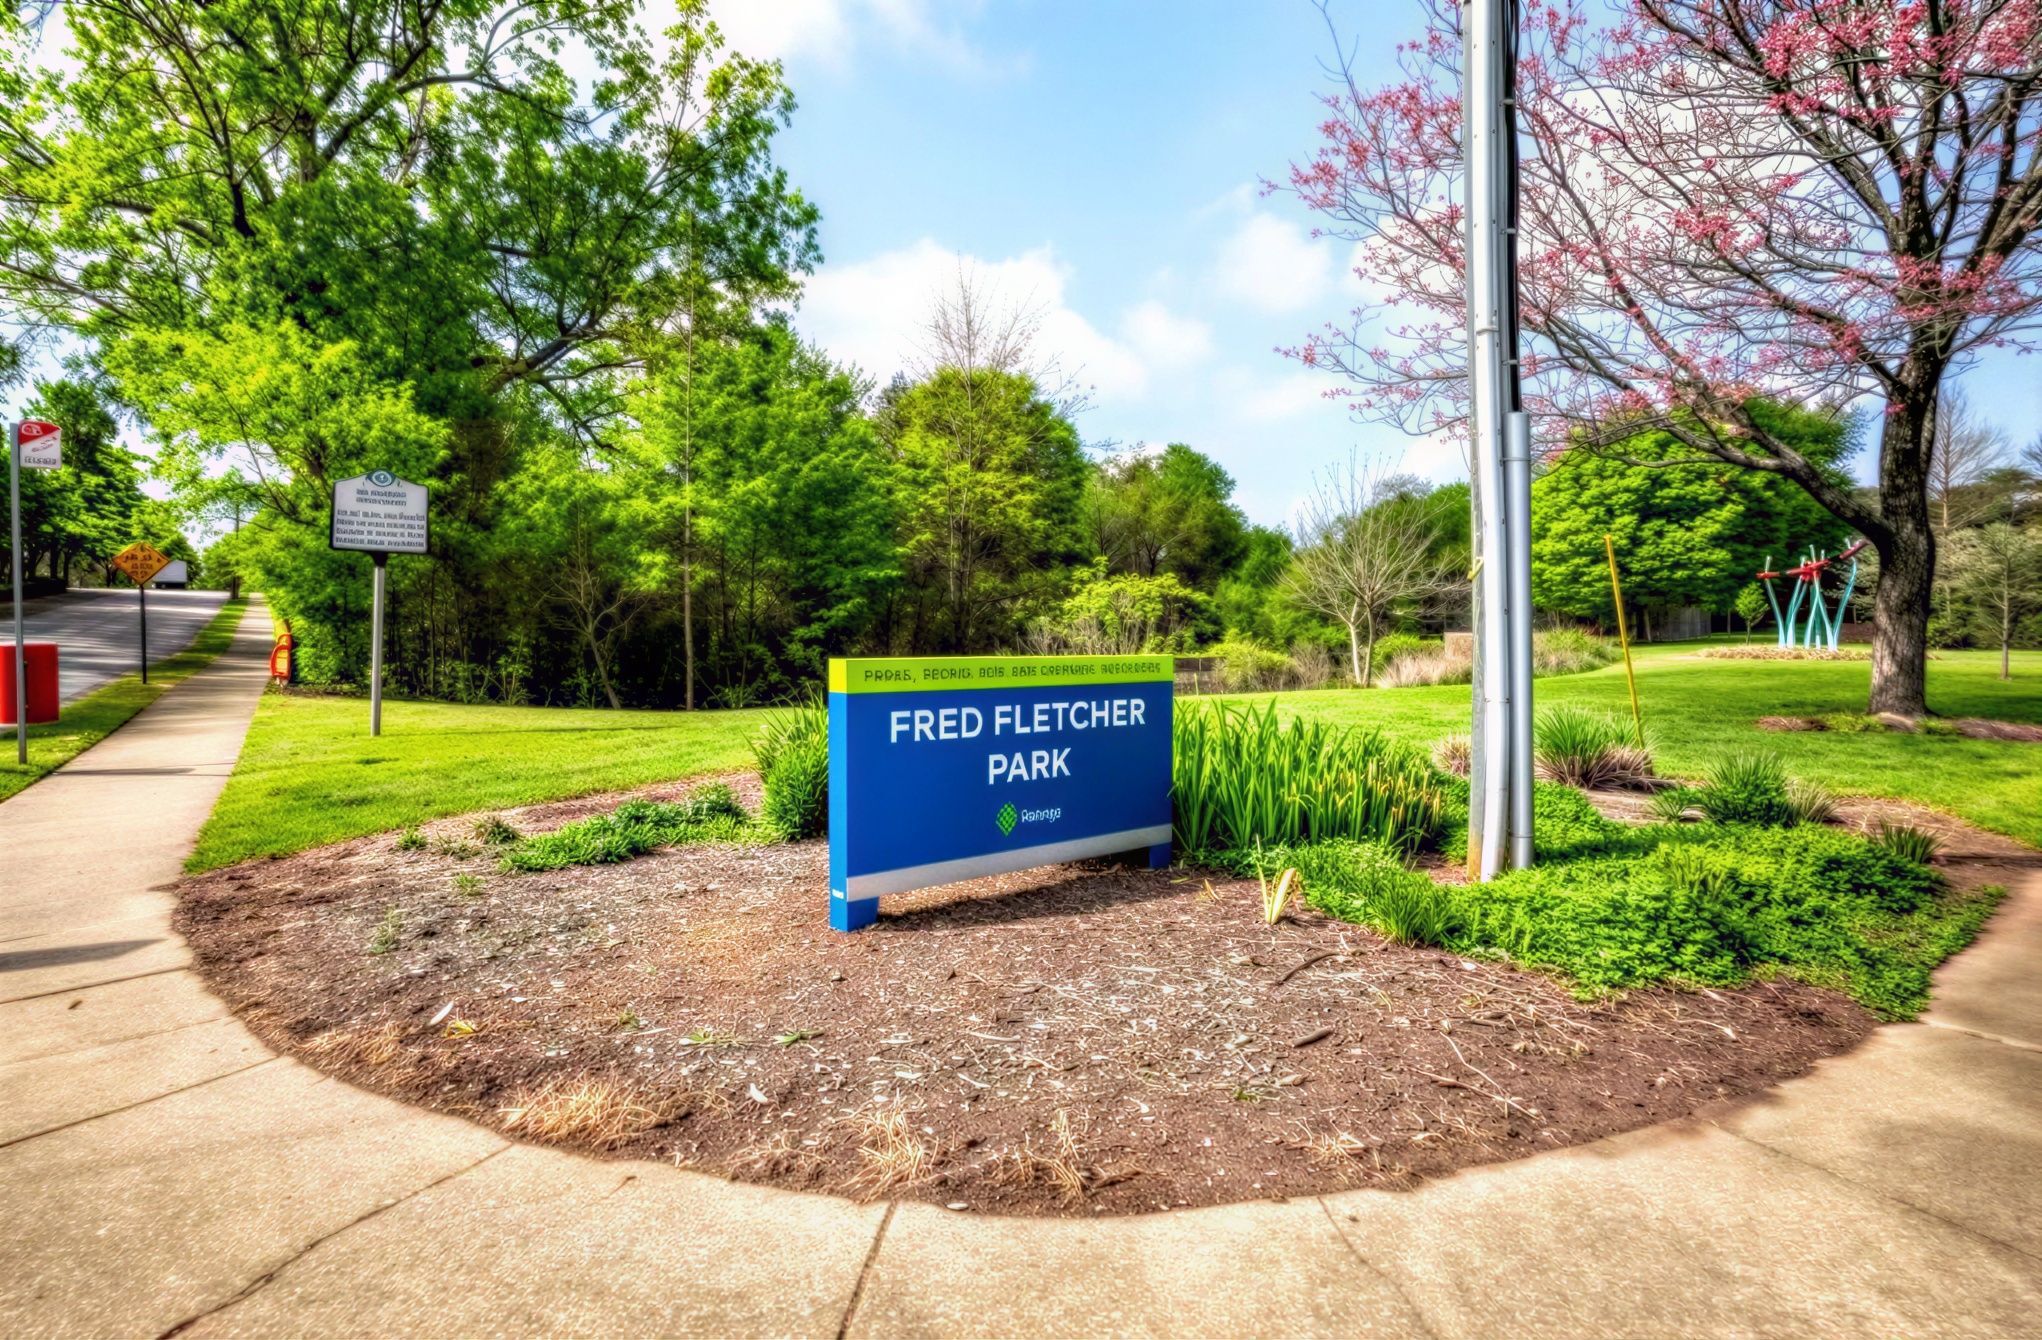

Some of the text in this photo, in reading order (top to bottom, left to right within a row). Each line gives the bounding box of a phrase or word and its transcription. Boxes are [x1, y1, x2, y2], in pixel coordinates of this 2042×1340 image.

[890, 699, 1145, 743] FRED FLETCHER
[988, 748, 1070, 784] PARK
